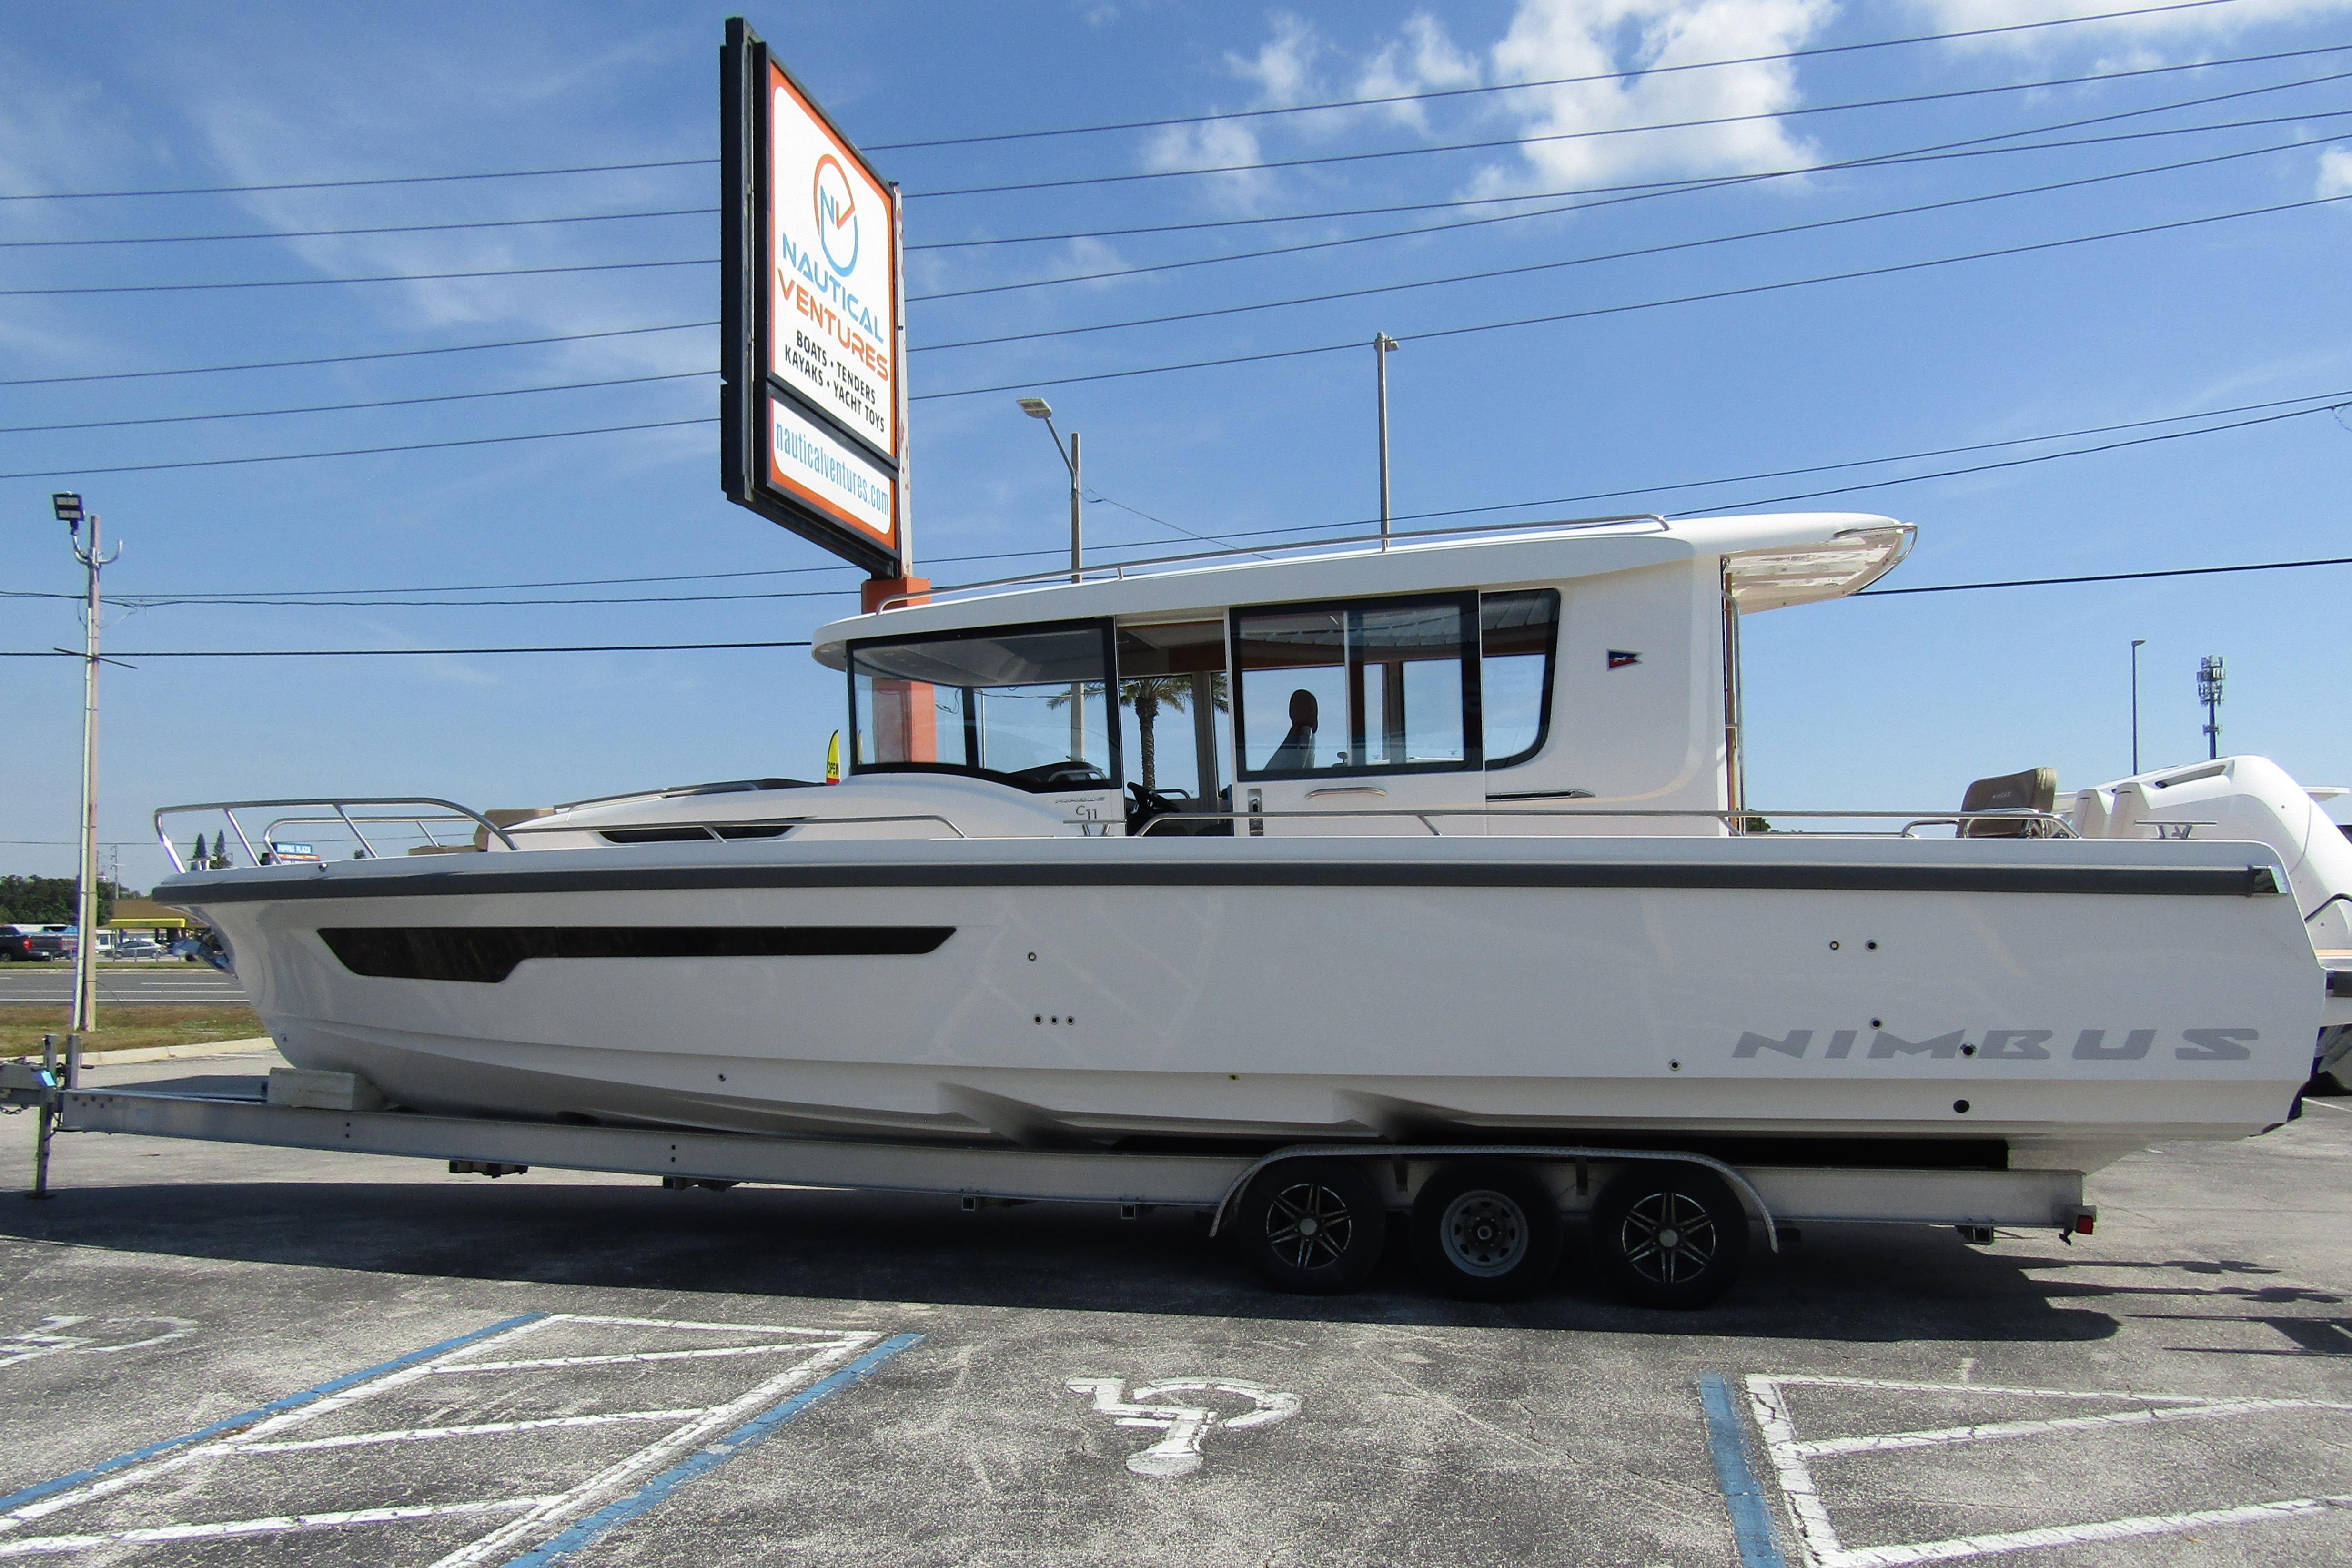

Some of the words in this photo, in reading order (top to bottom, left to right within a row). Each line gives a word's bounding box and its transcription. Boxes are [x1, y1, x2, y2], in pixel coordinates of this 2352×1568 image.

[777, 266, 888, 381] VENTURES
[783, 233, 884, 344] NAUTICAL
[785, 344, 823, 387] KAYAKS
[833, 380, 862, 416] YACHT
[865, 404, 885, 433] TOYS
[797, 329, 827, 367] BOATS
[837, 360, 876, 405] TENDERS
[776, 422, 889, 517] nauticalventures.com
[296, 845, 311, 854] PLAZA
[1076, 805, 1097, 820] C11
[1731, 1028, 2260, 1061] NIMBUS
